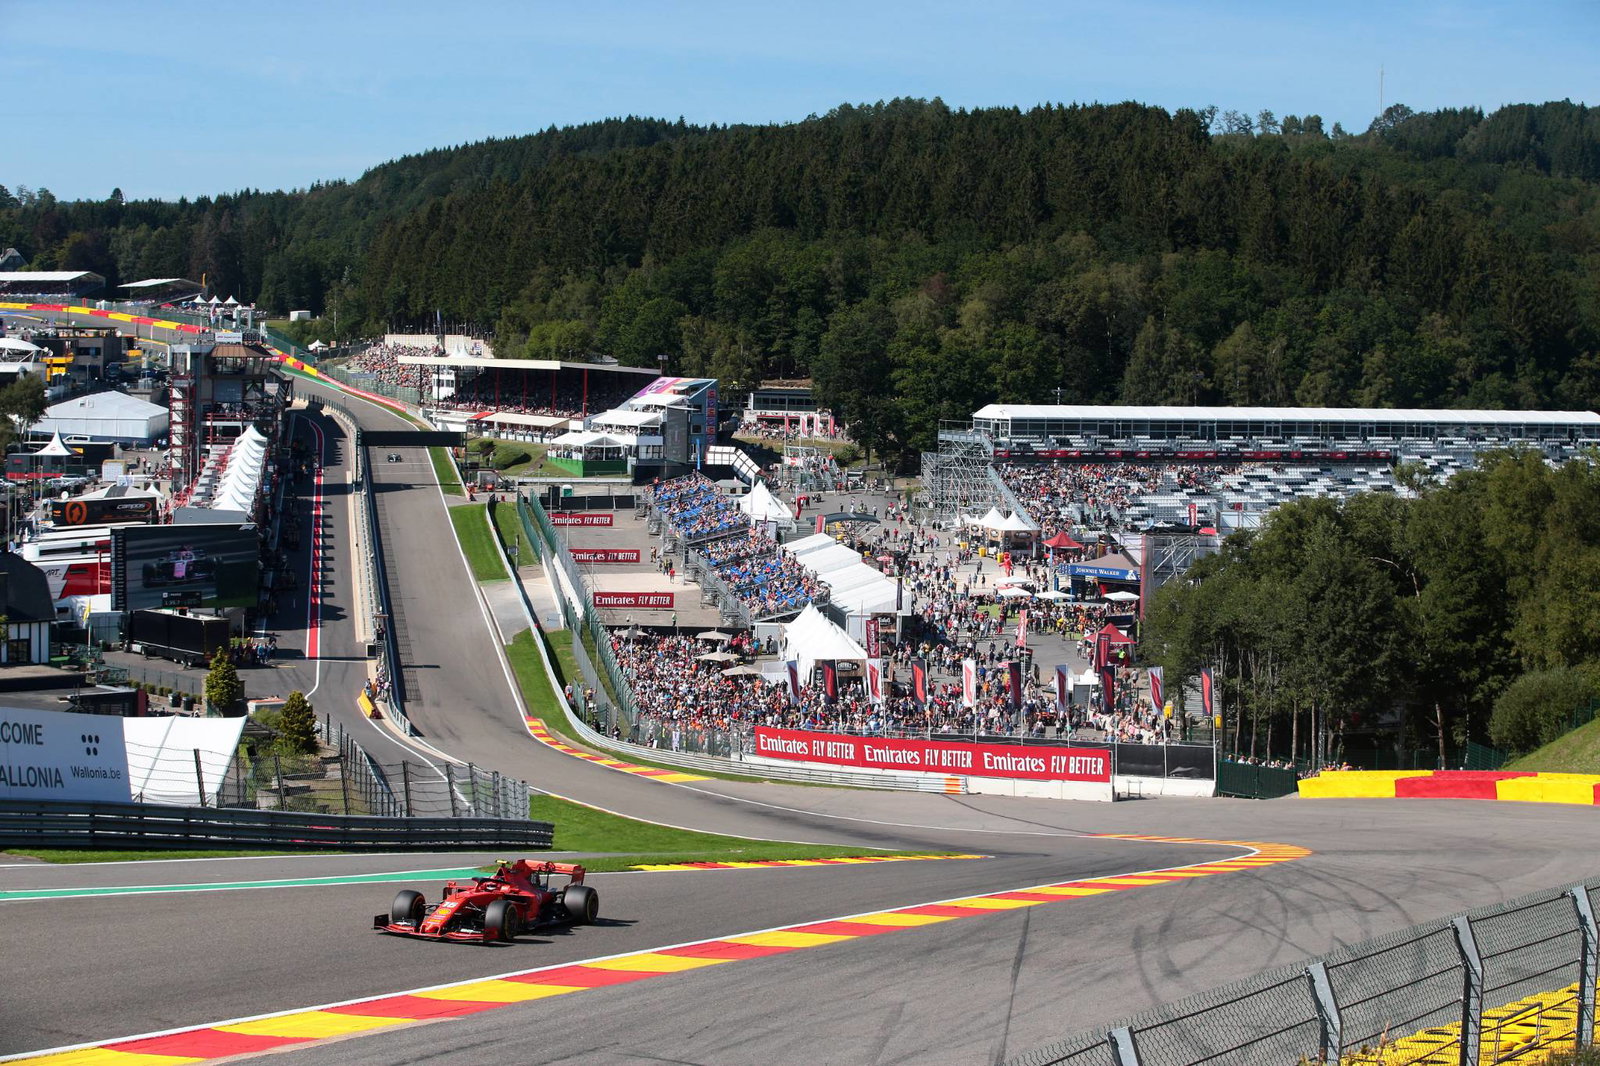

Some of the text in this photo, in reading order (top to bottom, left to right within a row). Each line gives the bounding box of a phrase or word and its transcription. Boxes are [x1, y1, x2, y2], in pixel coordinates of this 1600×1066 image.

[595, 595, 671, 605] Emirates FLY BETTER
[0, 721, 44, 746] COME
[759, 733, 855, 760] Emirates FLY BETTER
[864, 744, 973, 768] Emirates FLY BETTER
[70, 765, 121, 780] Wallonia.be
[983, 752, 1104, 775] Emirates FLY BETTER
